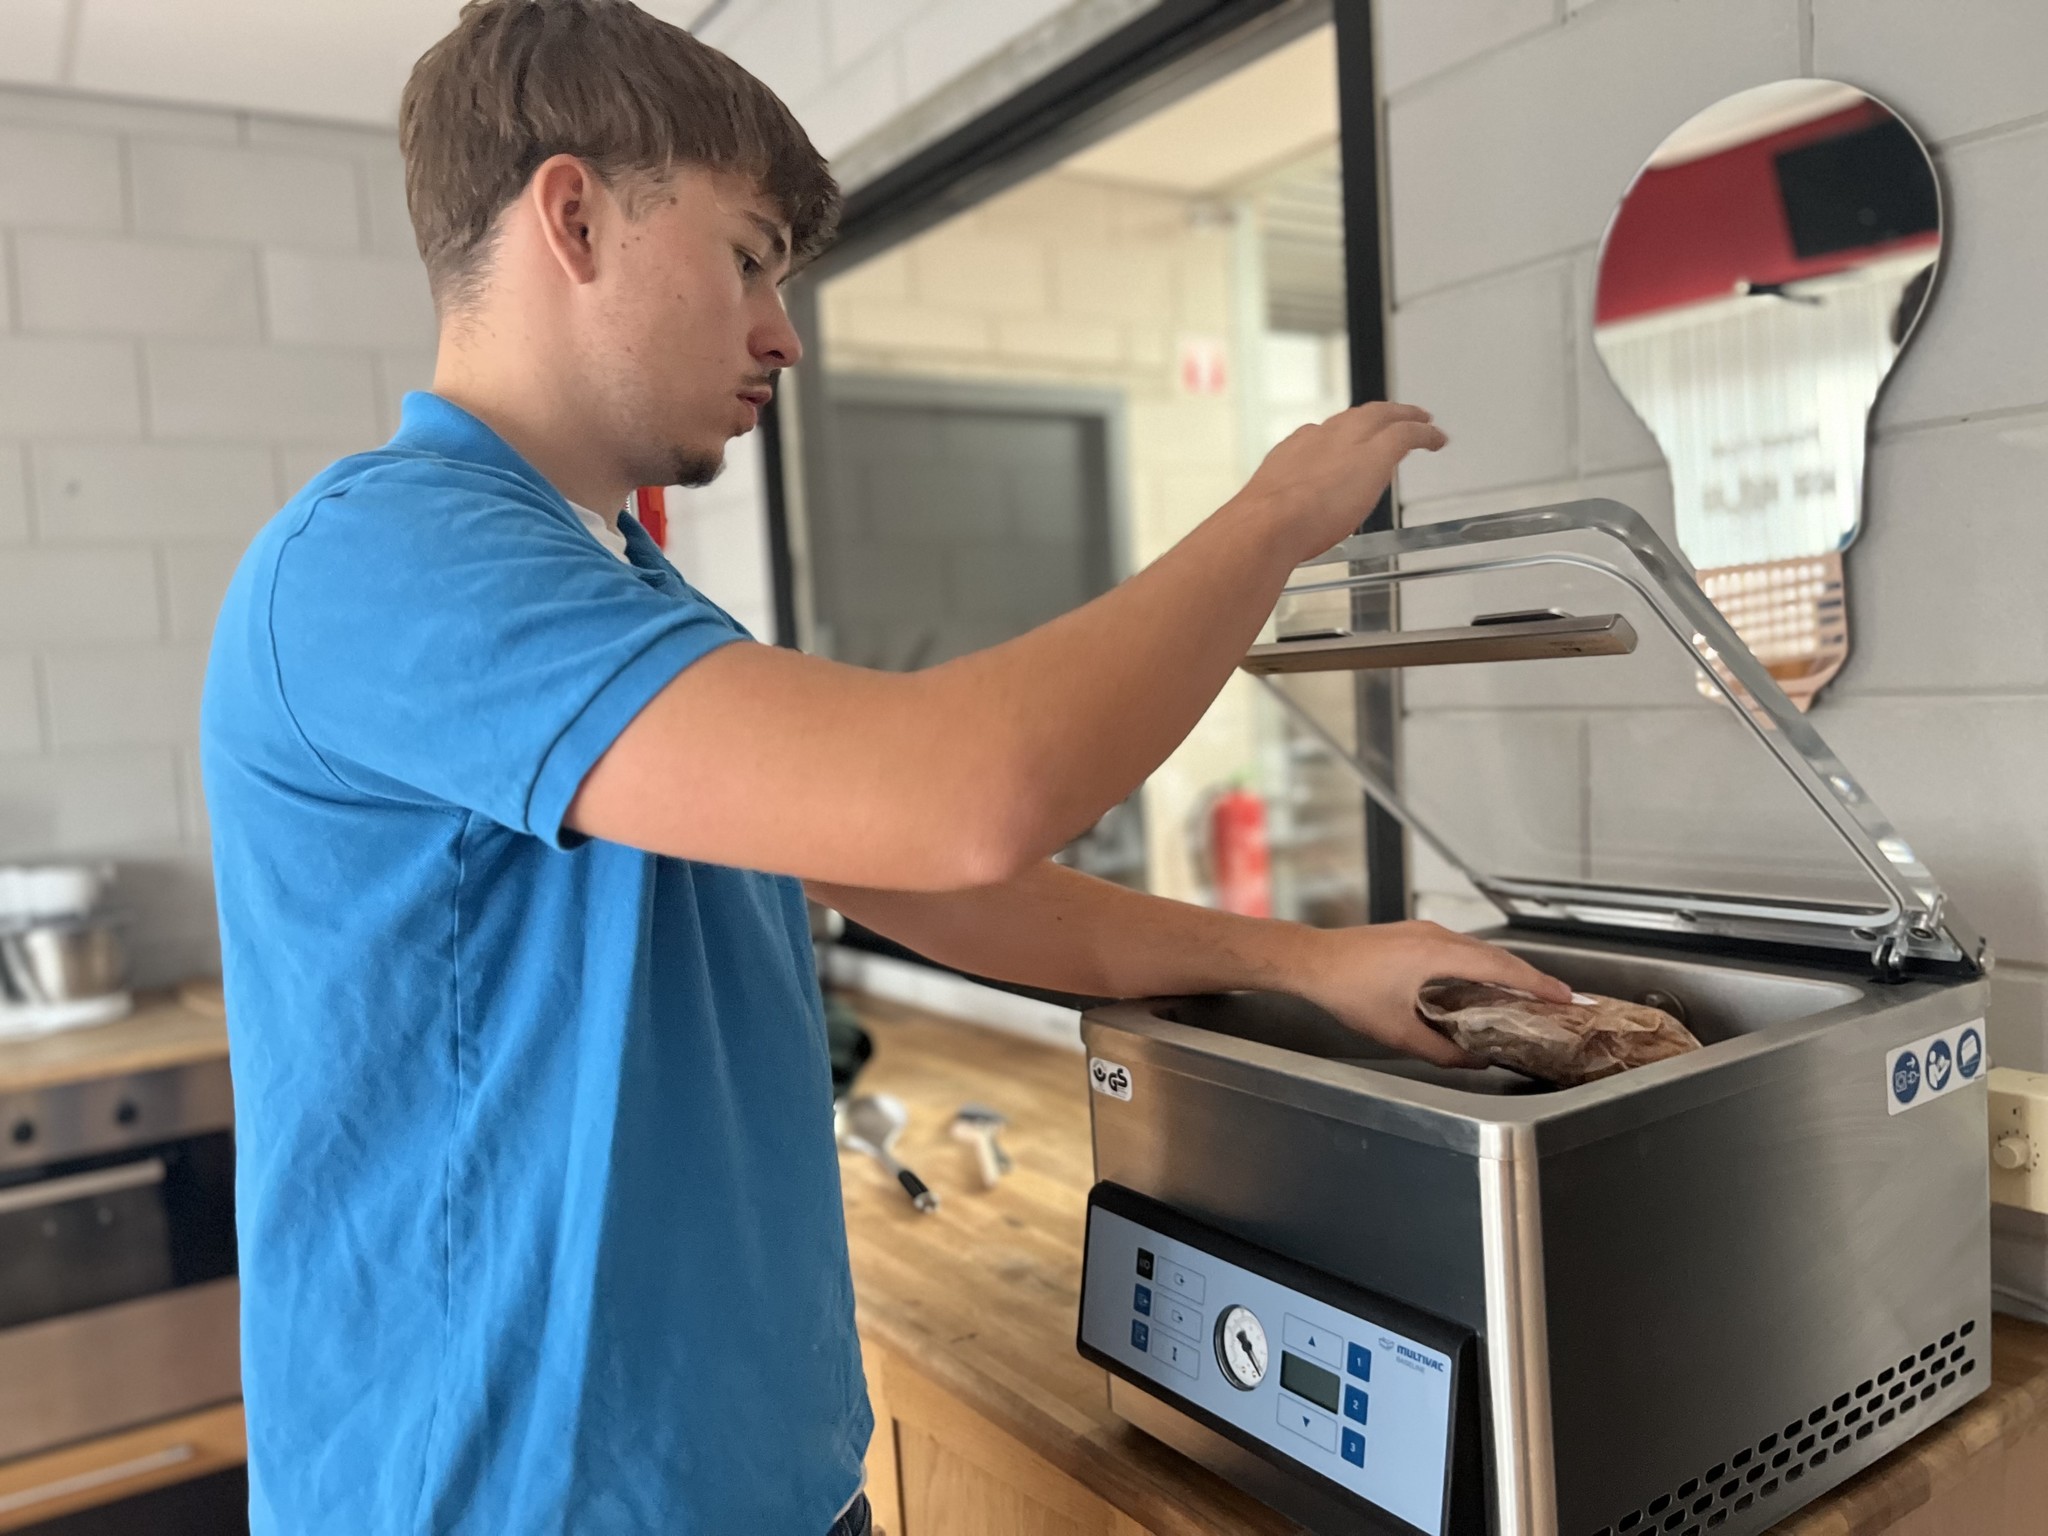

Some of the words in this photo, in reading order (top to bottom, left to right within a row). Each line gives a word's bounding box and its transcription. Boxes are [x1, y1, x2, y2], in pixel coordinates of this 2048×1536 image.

[1108, 1067, 1128, 1092] GS
[1396, 1344, 1444, 1373] MULTIVAC
[1353, 1399, 1360, 1411] 2
[1349, 1442, 1357, 1453] 3
